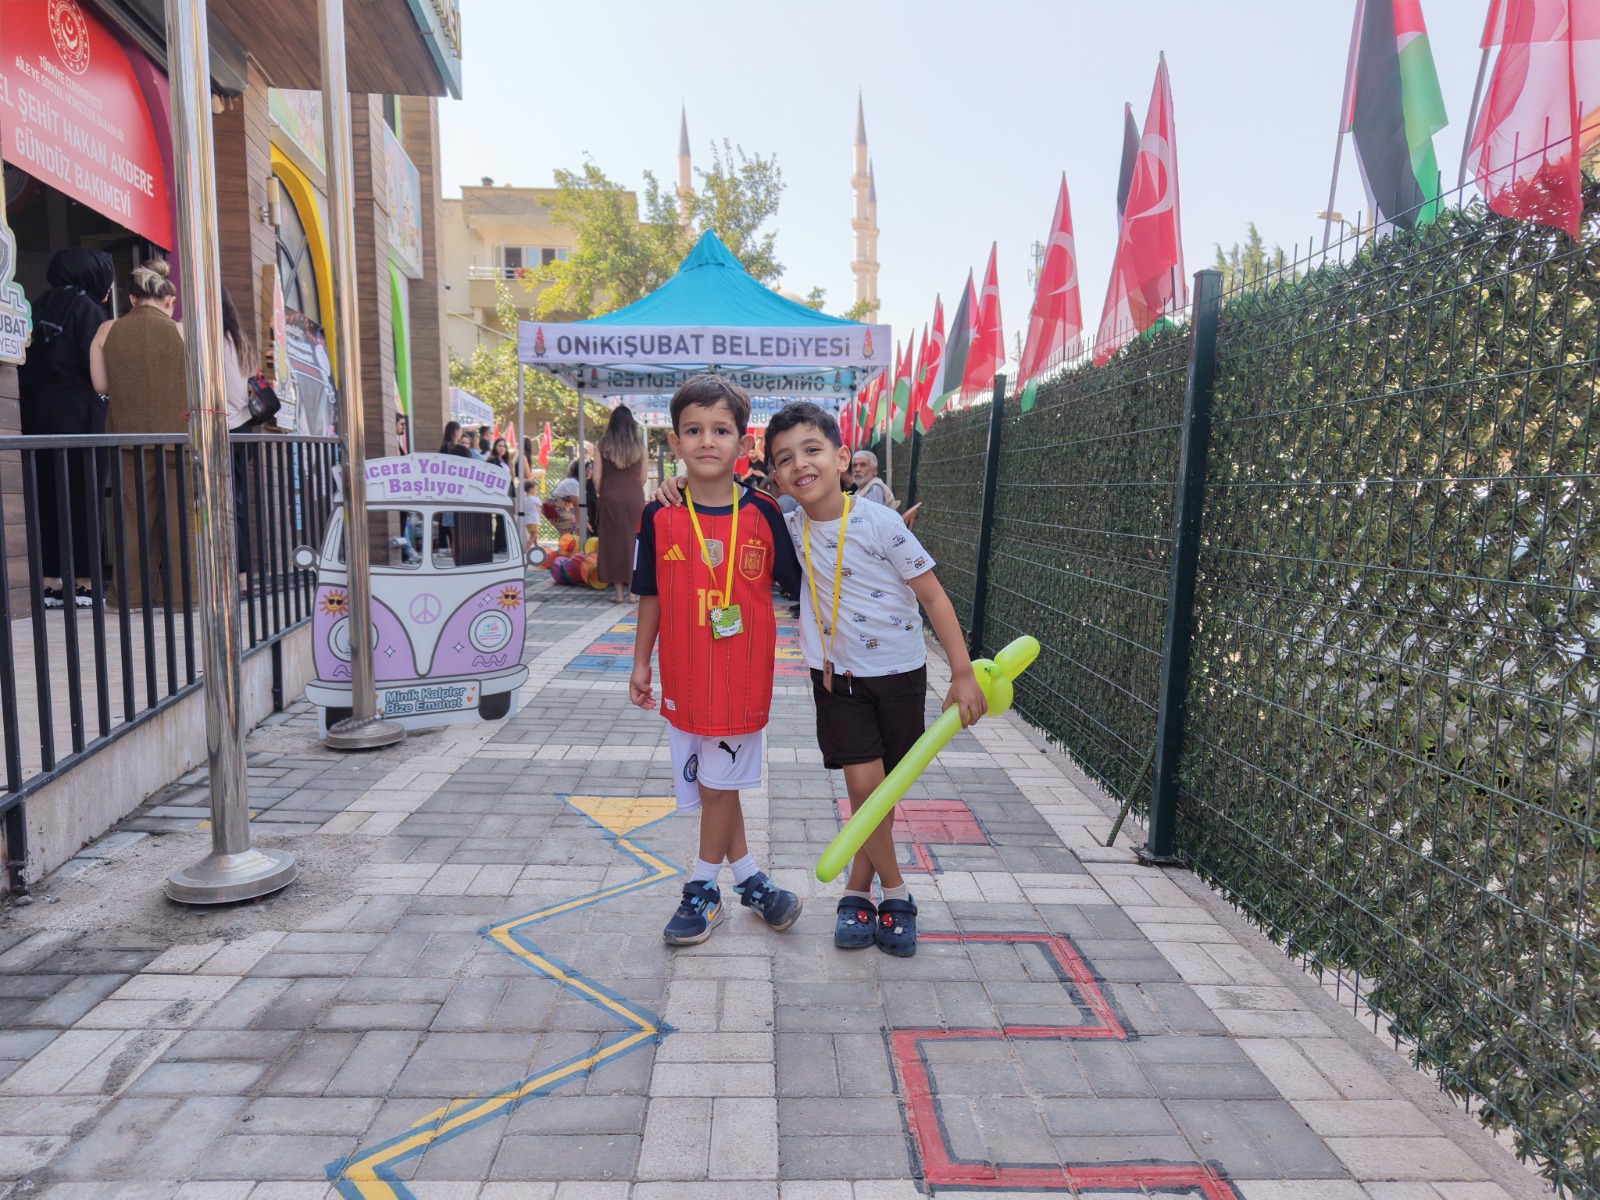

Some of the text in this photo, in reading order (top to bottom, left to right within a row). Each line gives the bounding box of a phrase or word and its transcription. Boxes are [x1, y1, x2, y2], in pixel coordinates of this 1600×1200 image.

[15, 55, 31, 77] AİLE
[31, 66, 40, 83] VE
[41, 74, 65, 100] SOSYAL
[39, 55, 65, 84] TÜRKİYE
[18, 87, 59, 137] ŞEHİT
[63, 116, 107, 168] HAKAN
[110, 152, 154, 198] AKDERE
[15, 126, 131, 218] GÜNDÜZ BAKIMEVİ
[388, 478, 465, 496] Başlıyor
[417, 459, 507, 490] Yolculuğu
[385, 686, 466, 703] Minik Kalpler
[385, 698, 463, 714] Bize Emanet
